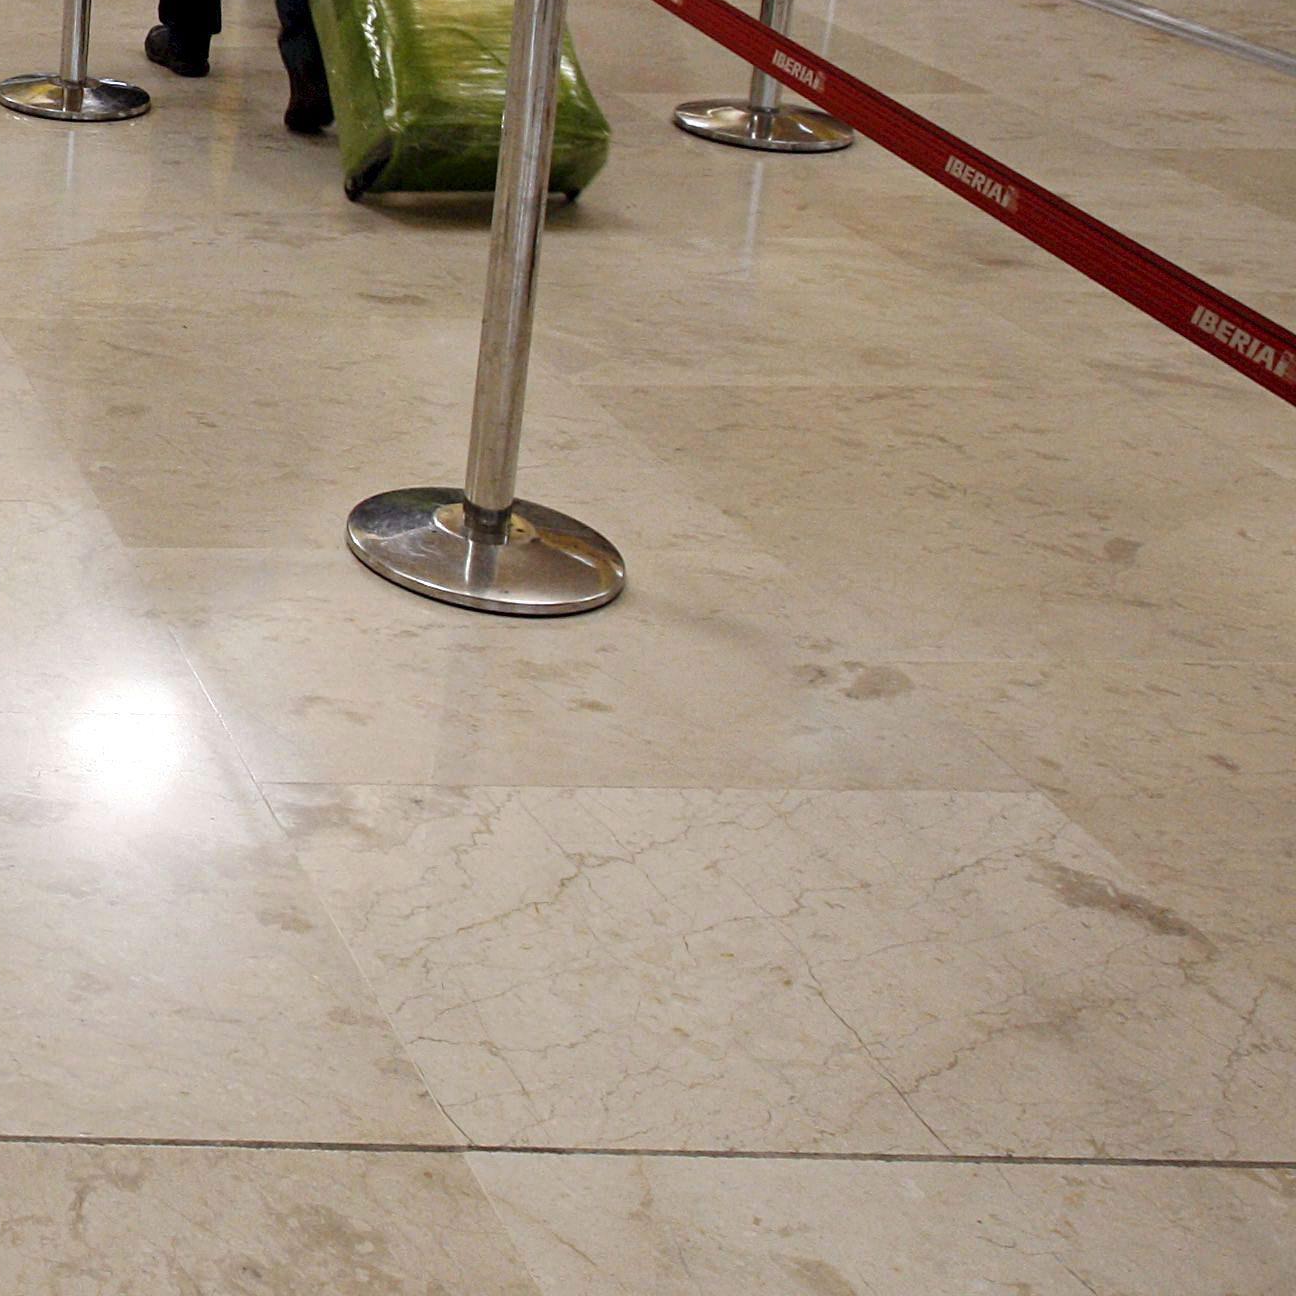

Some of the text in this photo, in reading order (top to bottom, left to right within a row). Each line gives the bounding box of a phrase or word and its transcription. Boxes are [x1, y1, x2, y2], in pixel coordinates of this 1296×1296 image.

[772, 49, 815, 85] IBERIA
[945, 155, 1003, 204] IBERIA
[1191, 305, 1275, 372] IBERIA
